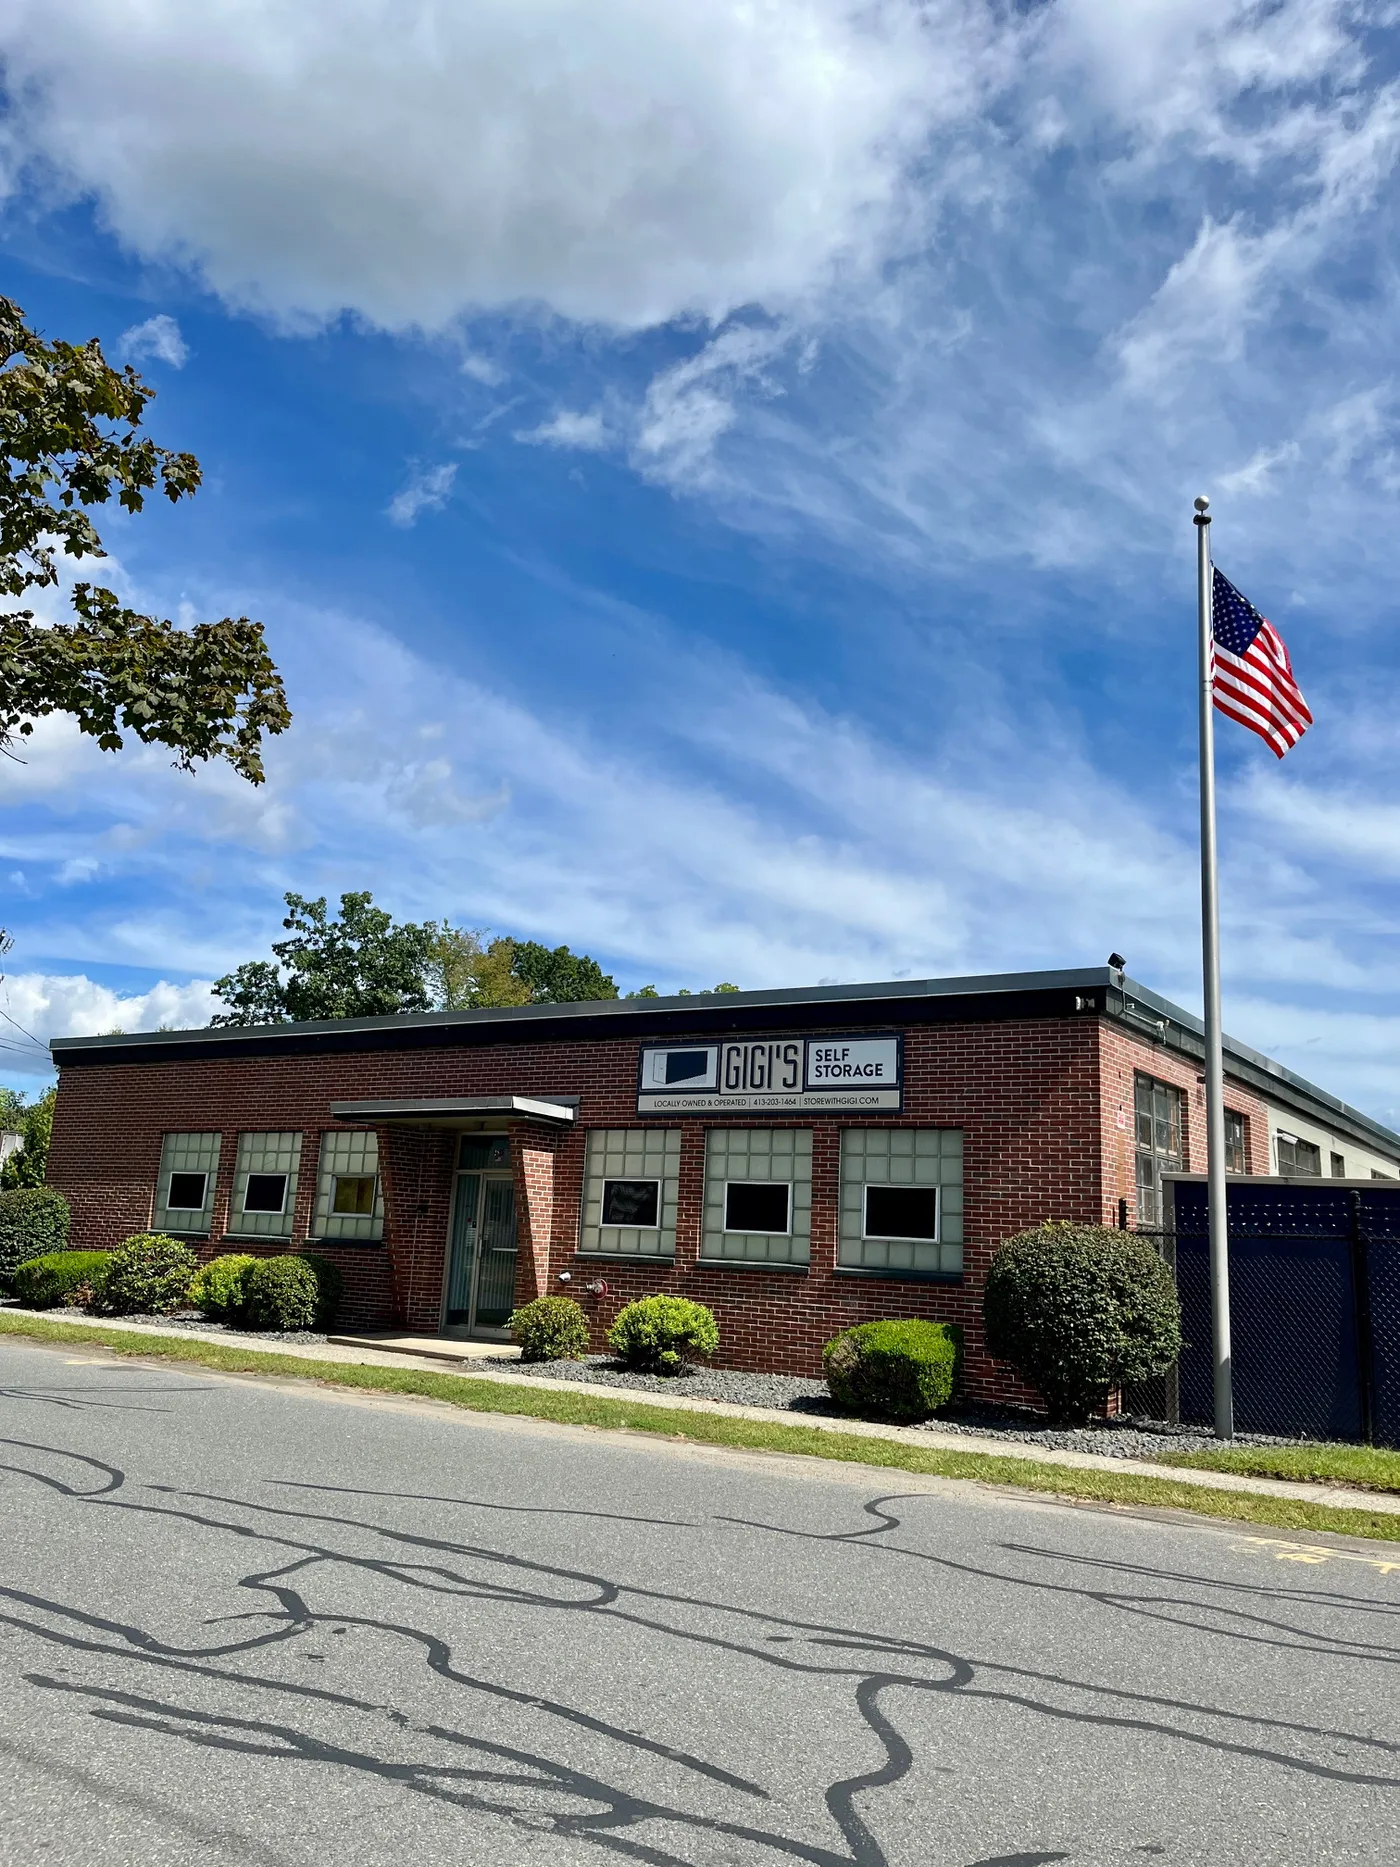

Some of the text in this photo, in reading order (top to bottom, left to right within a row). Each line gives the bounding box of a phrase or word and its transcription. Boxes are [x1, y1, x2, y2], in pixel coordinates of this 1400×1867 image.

[815, 1048, 850, 1062] SELF
[726, 1045, 798, 1090] GIGI'S
[815, 1063, 883, 1078] STORAGE
[654, 1096, 879, 1108] LOCALLY OWNED & OPERATED 413-203-1464 STOREWITHGIGI.COM
